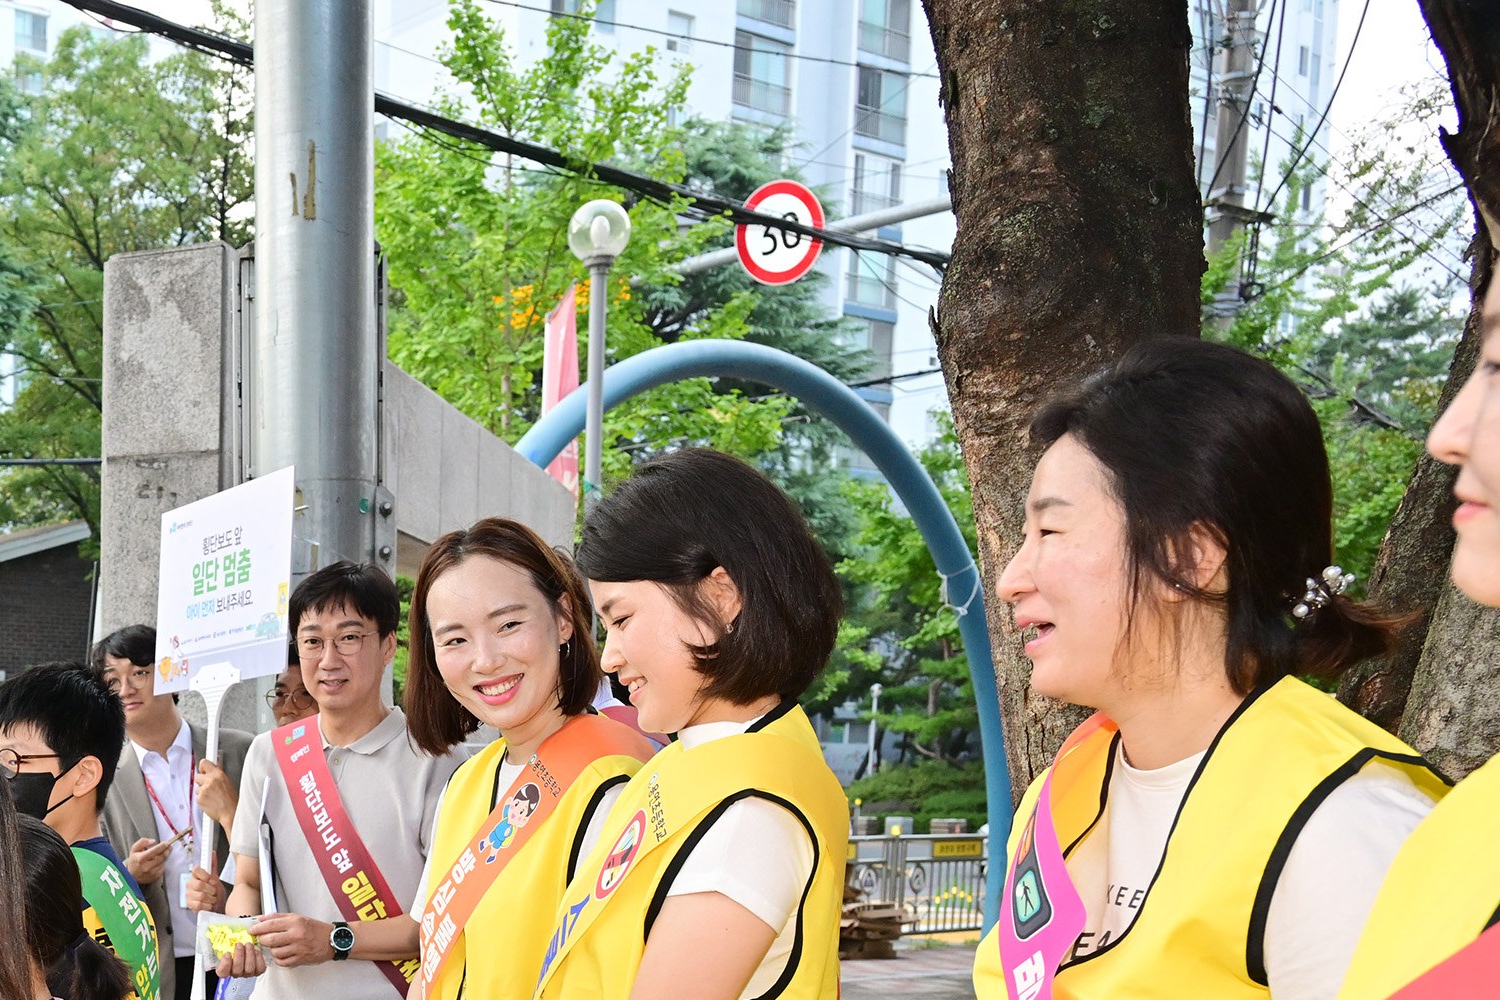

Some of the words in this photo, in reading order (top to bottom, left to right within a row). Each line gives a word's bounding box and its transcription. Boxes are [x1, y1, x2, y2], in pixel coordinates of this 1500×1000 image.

[202, 529, 232, 556] 횡단보도
[234, 525, 243, 546] 앞
[192, 557, 220, 596] 일단
[223, 548, 252, 588] 멈춤
[186, 600, 201, 621] 아이
[201, 597, 216, 618] 먼저
[533, 759, 562, 799] 용연초등학교
[299, 770, 343, 851] 횡단보도
[331, 847, 353, 874] 앞
[646, 782, 668, 843] 용연초등학교
[422, 912, 457, 986] 불행
